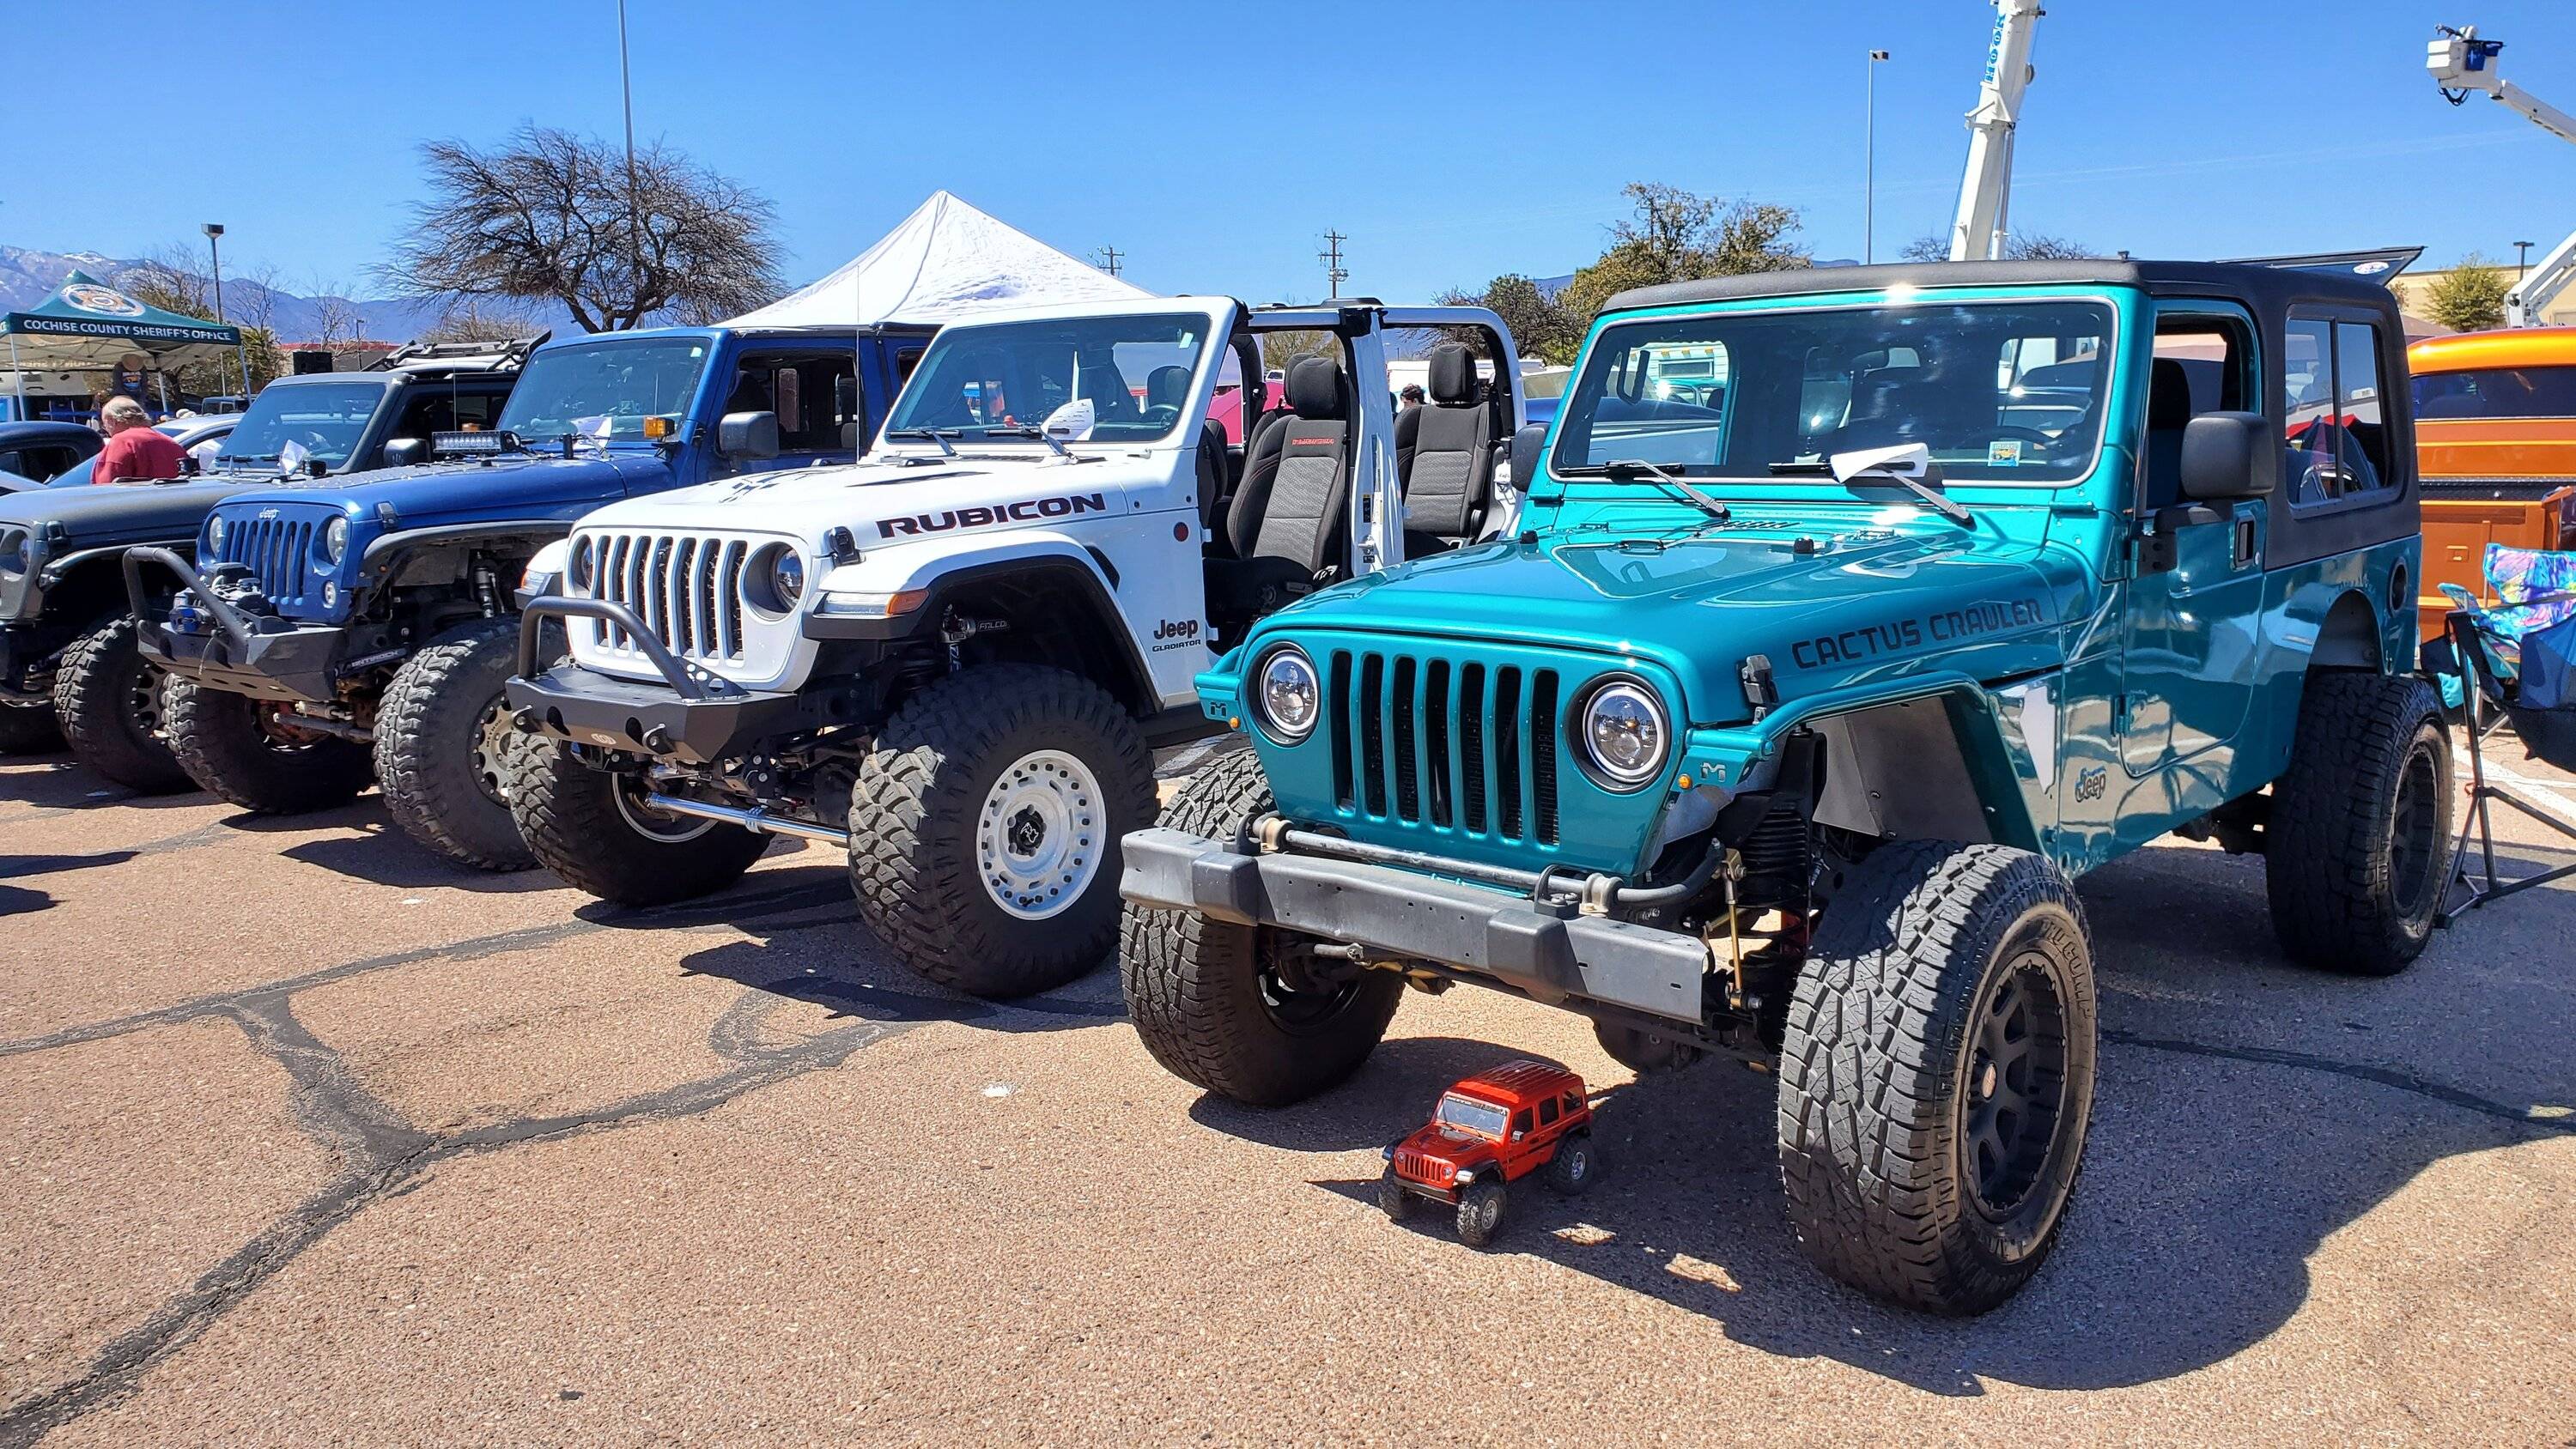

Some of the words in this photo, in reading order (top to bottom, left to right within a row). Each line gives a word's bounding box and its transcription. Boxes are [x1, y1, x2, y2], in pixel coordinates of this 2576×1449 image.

[1984, 14, 2006, 82] HOOK
[23, 318, 77, 332] COCHISE
[80, 322, 130, 335] COUNTY
[132, 326, 190, 338] SHERIFF'S
[191, 330, 231, 341] OFFICE
[875, 493, 1107, 539] RUBICON
[1151, 639, 1201, 652] GLADIATOR
[1153, 619, 1199, 640] Jeep
[1791, 618, 1922, 670] CACTUS
[1929, 598, 2044, 640] CRAWLER
[2075, 766, 2106, 803] Jeep
